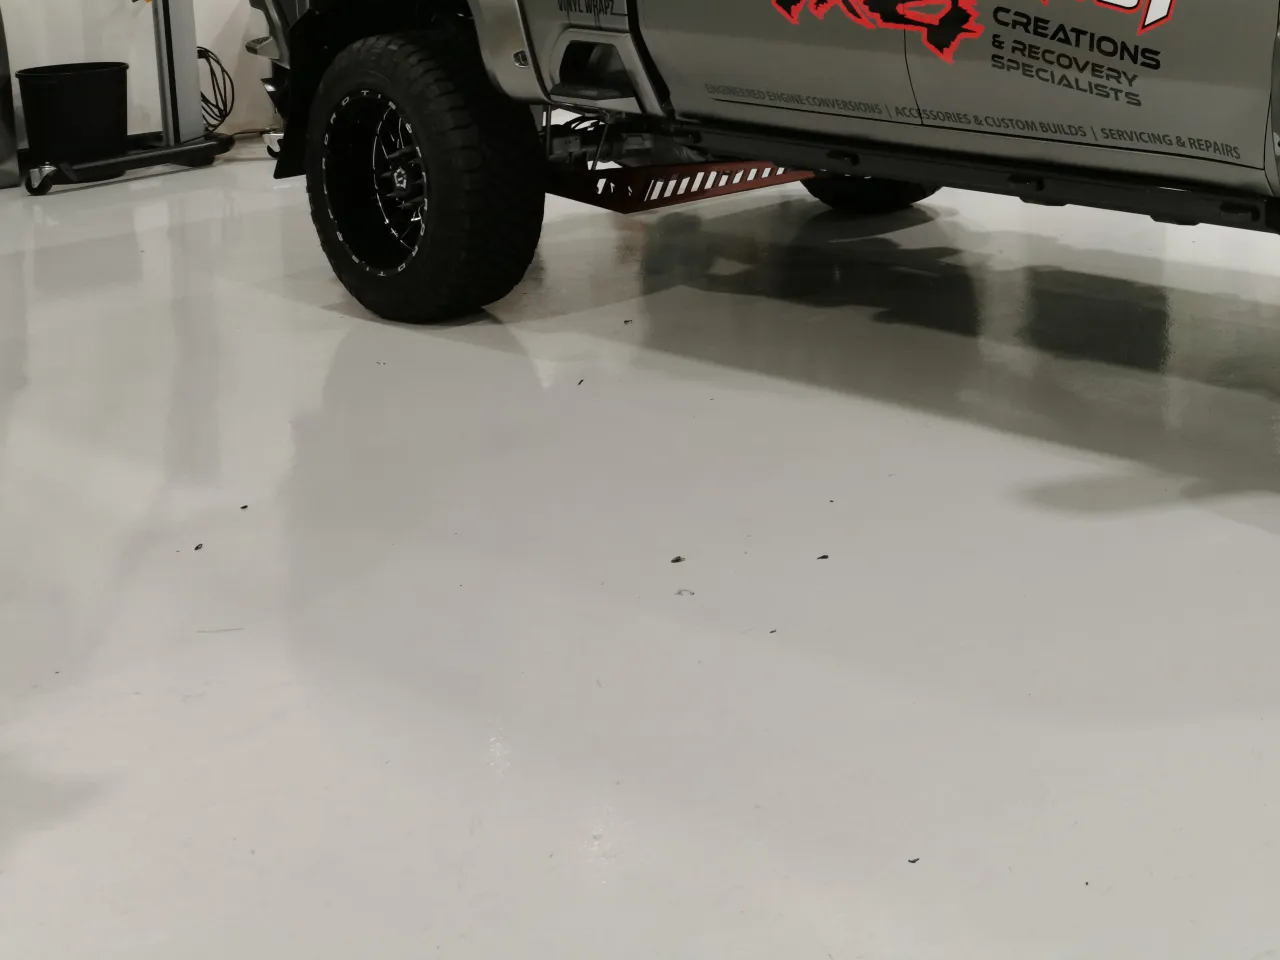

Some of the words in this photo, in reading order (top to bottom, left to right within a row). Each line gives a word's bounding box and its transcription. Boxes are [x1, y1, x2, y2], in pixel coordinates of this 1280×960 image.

[991, 34, 1006, 50] &
[1011, 39, 1139, 88] RECOVERY
[992, 5, 1162, 70] CREATIONS
[990, 53, 1142, 107] SPECIALISTS
[705, 83, 767, 101] ENGINEERED
[767, 91, 806, 106] ENGINE
[806, 94, 883, 115] CONVERSIONS
[895, 105, 971, 125] ACCESSORIES
[985, 116, 1038, 132] CUSTOM
[1040, 121, 1087, 138] BUILDS
[1100, 127, 1174, 147] SERVICING
[1188, 136, 1241, 160] REPAIRS
